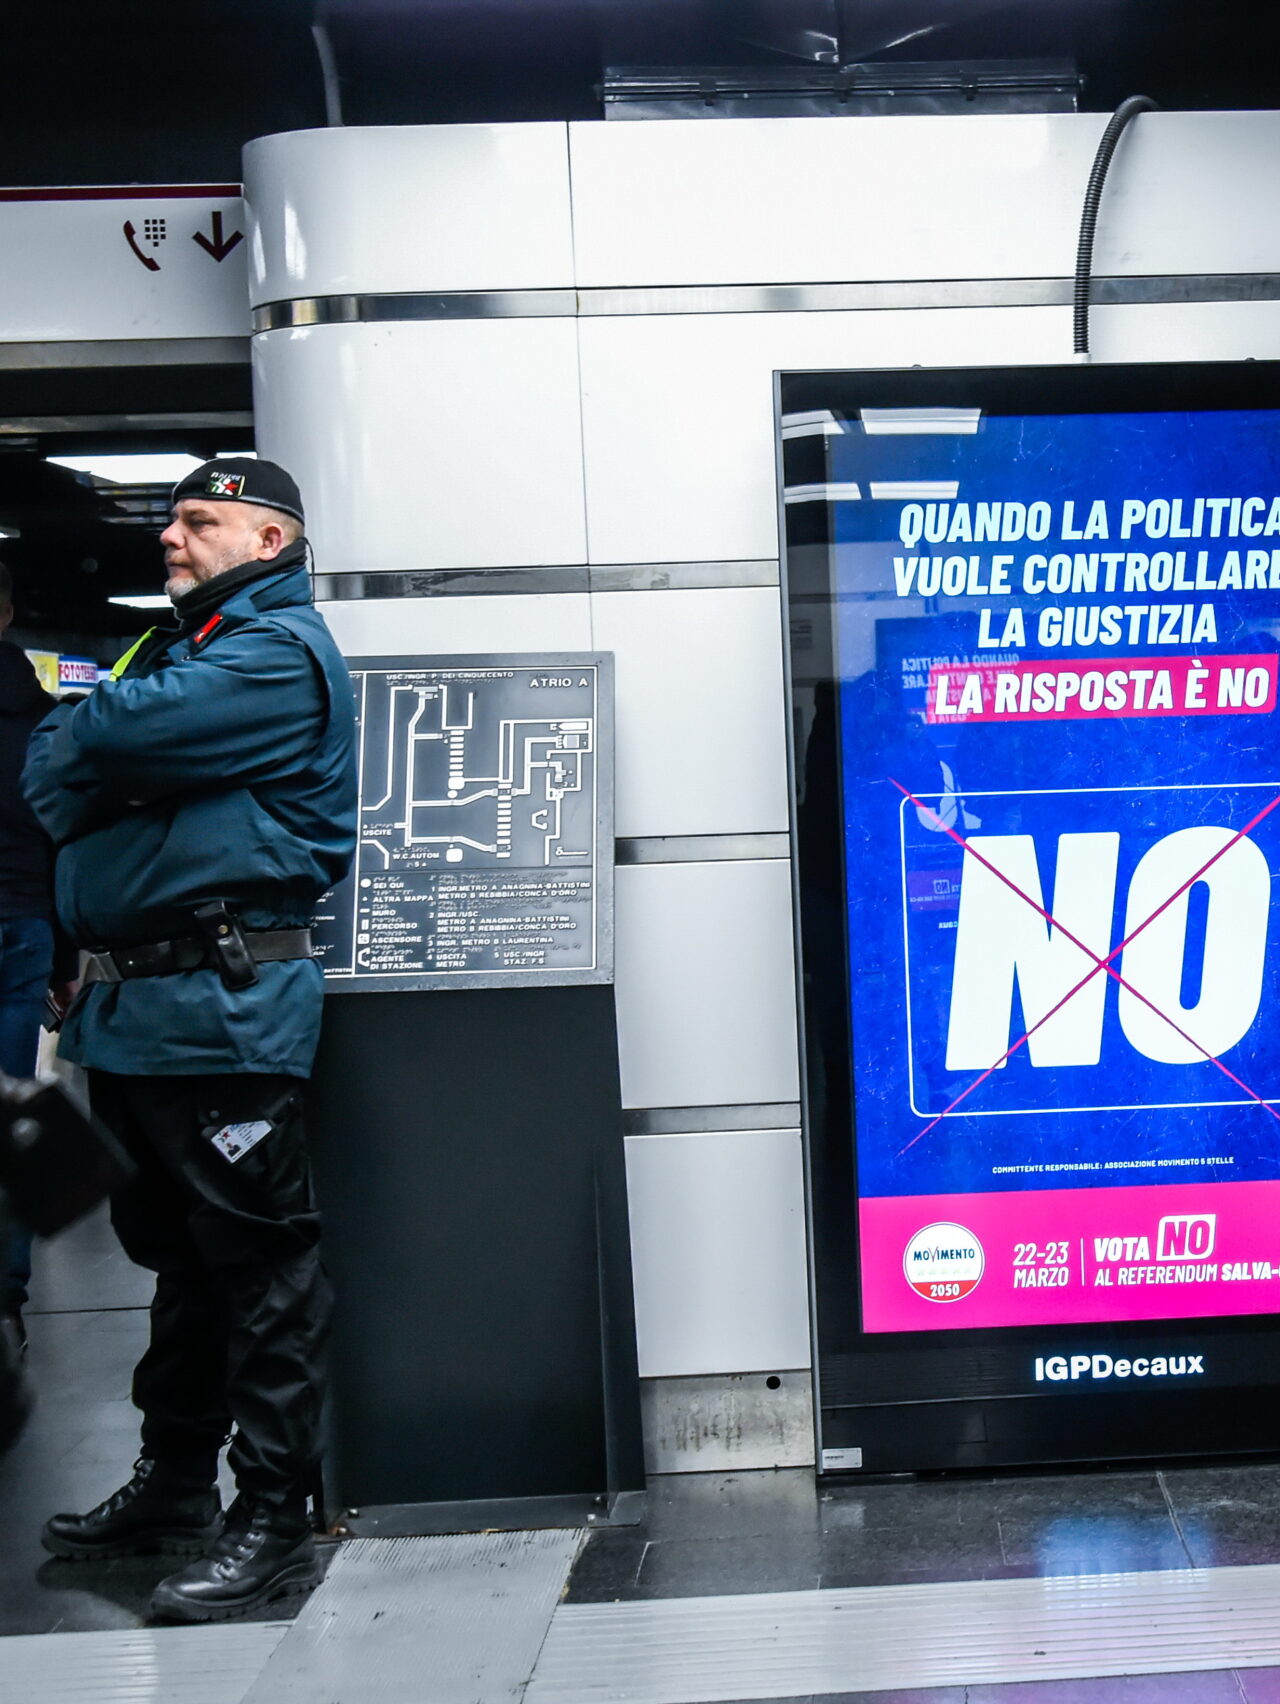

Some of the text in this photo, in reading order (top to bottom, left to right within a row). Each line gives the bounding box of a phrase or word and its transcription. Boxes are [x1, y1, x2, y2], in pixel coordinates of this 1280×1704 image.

[899, 501, 1051, 548] QUANDO
[1061, 500, 1109, 540] LA
[893, 555, 1014, 597] VUOLE
[978, 604, 1217, 648] LA GIUSTIZIA
[458, 671, 514, 679] CINQUECENTO
[530, 678, 588, 688] ATRIO A
[934, 659, 1270, 715] LA RISPOSTA È NO
[437, 892, 467, 900] METRO
[371, 922, 418, 930] PERCORSO
[437, 918, 467, 926] METRO
[437, 925, 467, 933] METRO
[551, 922, 577, 930] D'ORO
[371, 935, 423, 944] ASCENSORE
[503, 937, 554, 945] LAURENTINA
[945, 826, 1271, 1071] NO
[381, 962, 424, 970] STAZIONE
[436, 960, 466, 968] METRO
[992, 1165, 1044, 1174] COMMITTENTE
[1045, 1162, 1103, 1172] RESPONSABILE:
[1104, 1160, 1157, 1170] ASSOCIAZIONE
[1157, 1158, 1200, 1167] MOVIMENTO
[1206, 1156, 1235, 1165] STELLE
[1094, 1220, 1211, 1262] VOTA NO
[1013, 1241, 1069, 1266] 22-23
[1013, 1266, 1069, 1289] MARZO
[1094, 1268, 1114, 1287] AL
[1118, 1264, 1218, 1286] REFERENDUM
[930, 1283, 960, 1297] 2050
[1035, 1354, 1205, 1381] IGPDecaux
